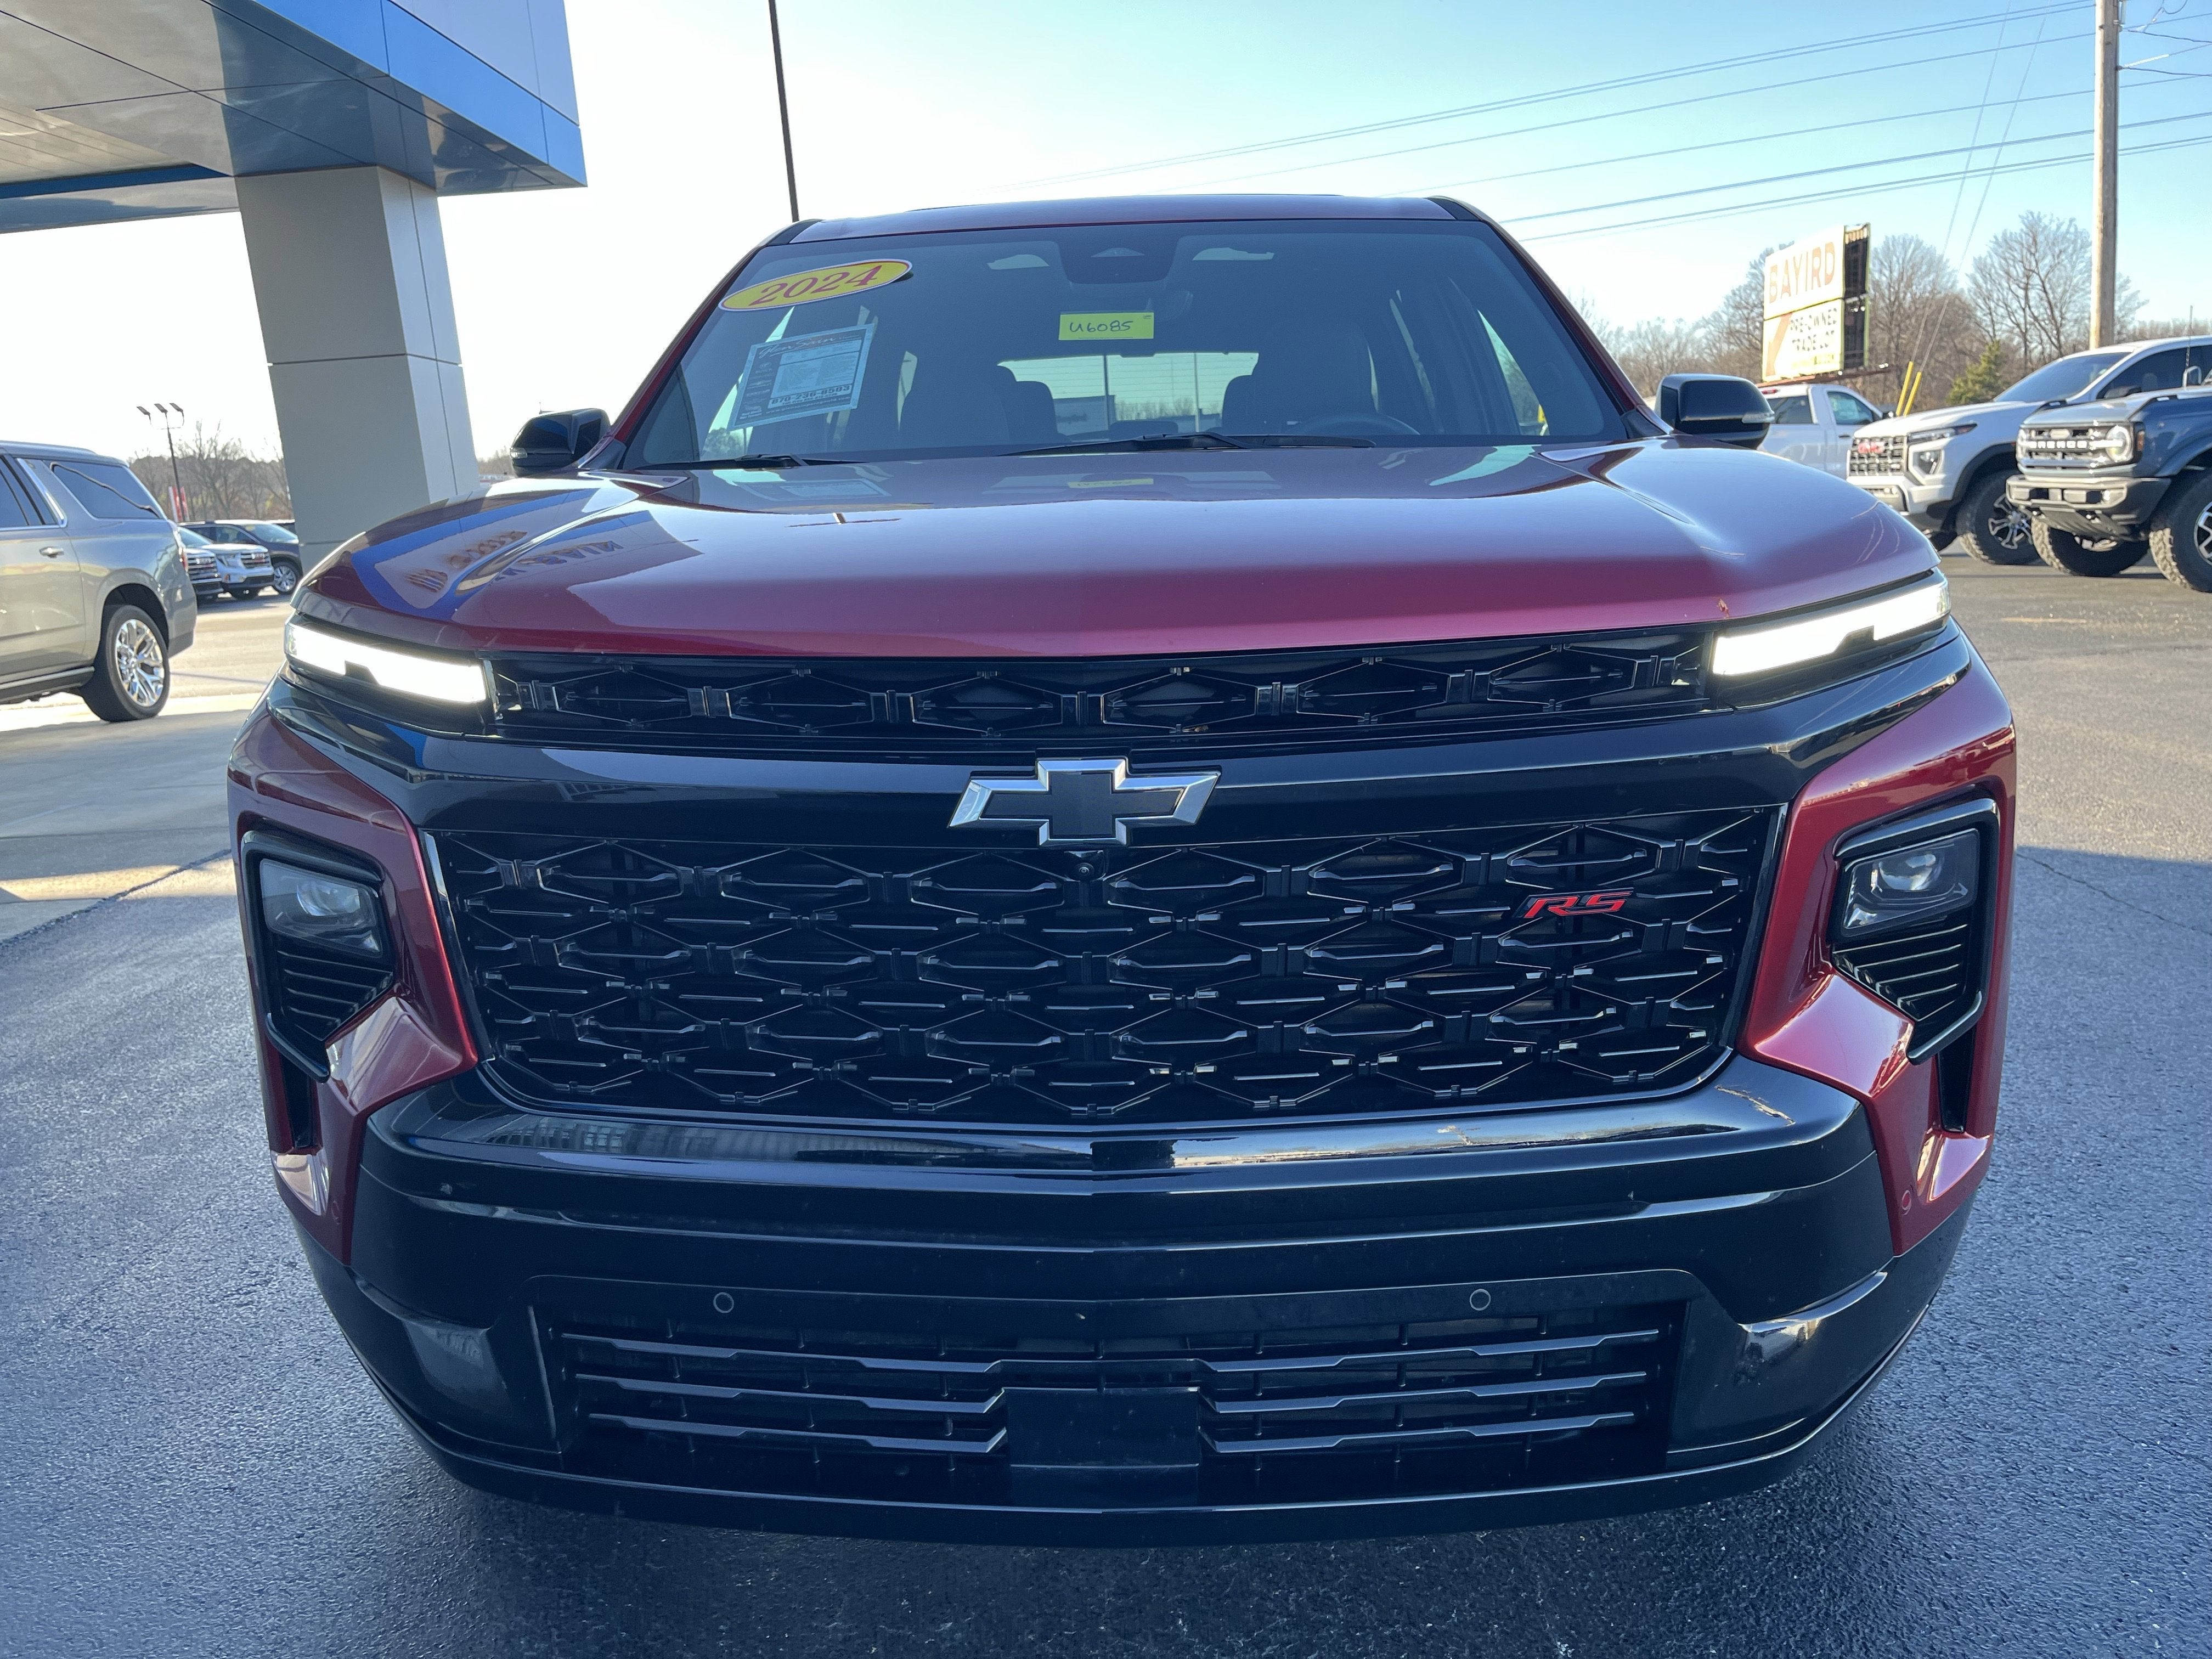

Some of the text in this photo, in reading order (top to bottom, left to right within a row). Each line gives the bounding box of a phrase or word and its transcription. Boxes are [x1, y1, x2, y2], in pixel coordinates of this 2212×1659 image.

[748, 266, 882, 306] 2024
[1769, 242, 1835, 303] BAYIRD
[771, 385, 850, 404] 870-236-8503
[1523, 892, 1632, 918] RS
